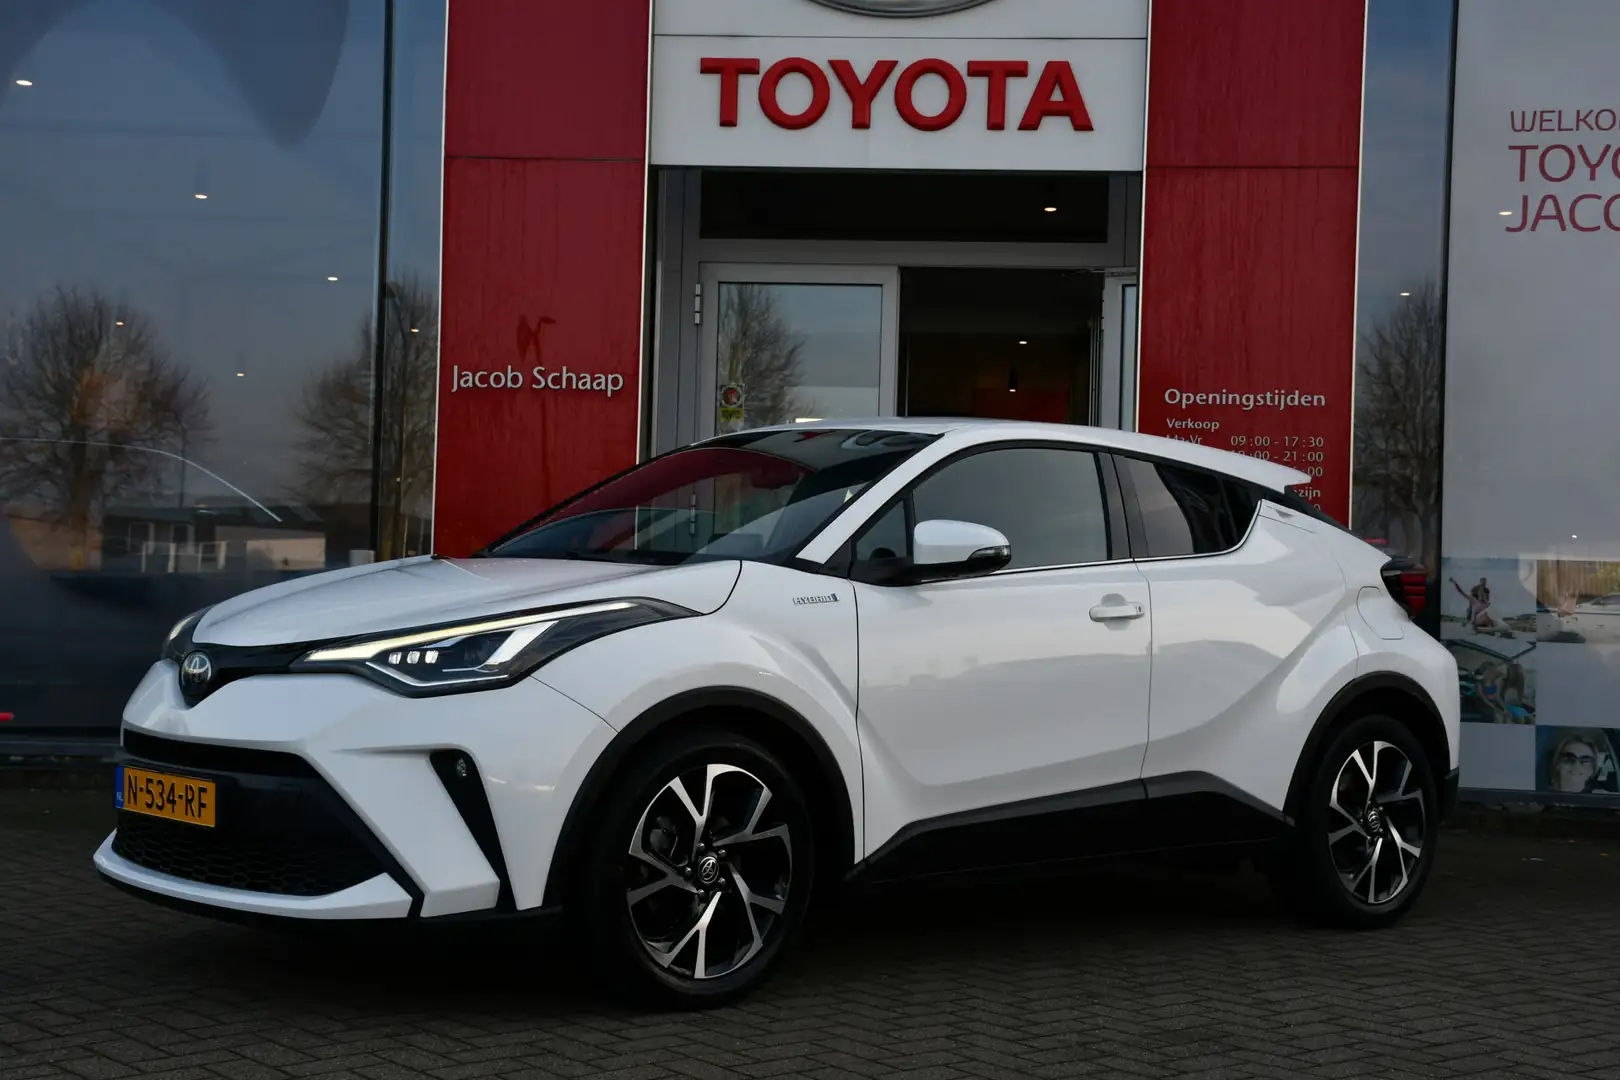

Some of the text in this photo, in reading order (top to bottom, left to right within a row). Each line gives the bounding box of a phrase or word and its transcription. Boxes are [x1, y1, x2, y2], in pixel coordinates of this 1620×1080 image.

[700, 57, 1094, 131] TOYOTA
[1510, 108, 1620, 132] WELKO
[1508, 144, 1620, 182] TOY
[451, 364, 624, 397] Jacob Schaap
[1164, 388, 1326, 410] Openingstijden
[1166, 418, 1220, 432] Verkoop
[127, 773, 208, 818] N-534-RF
